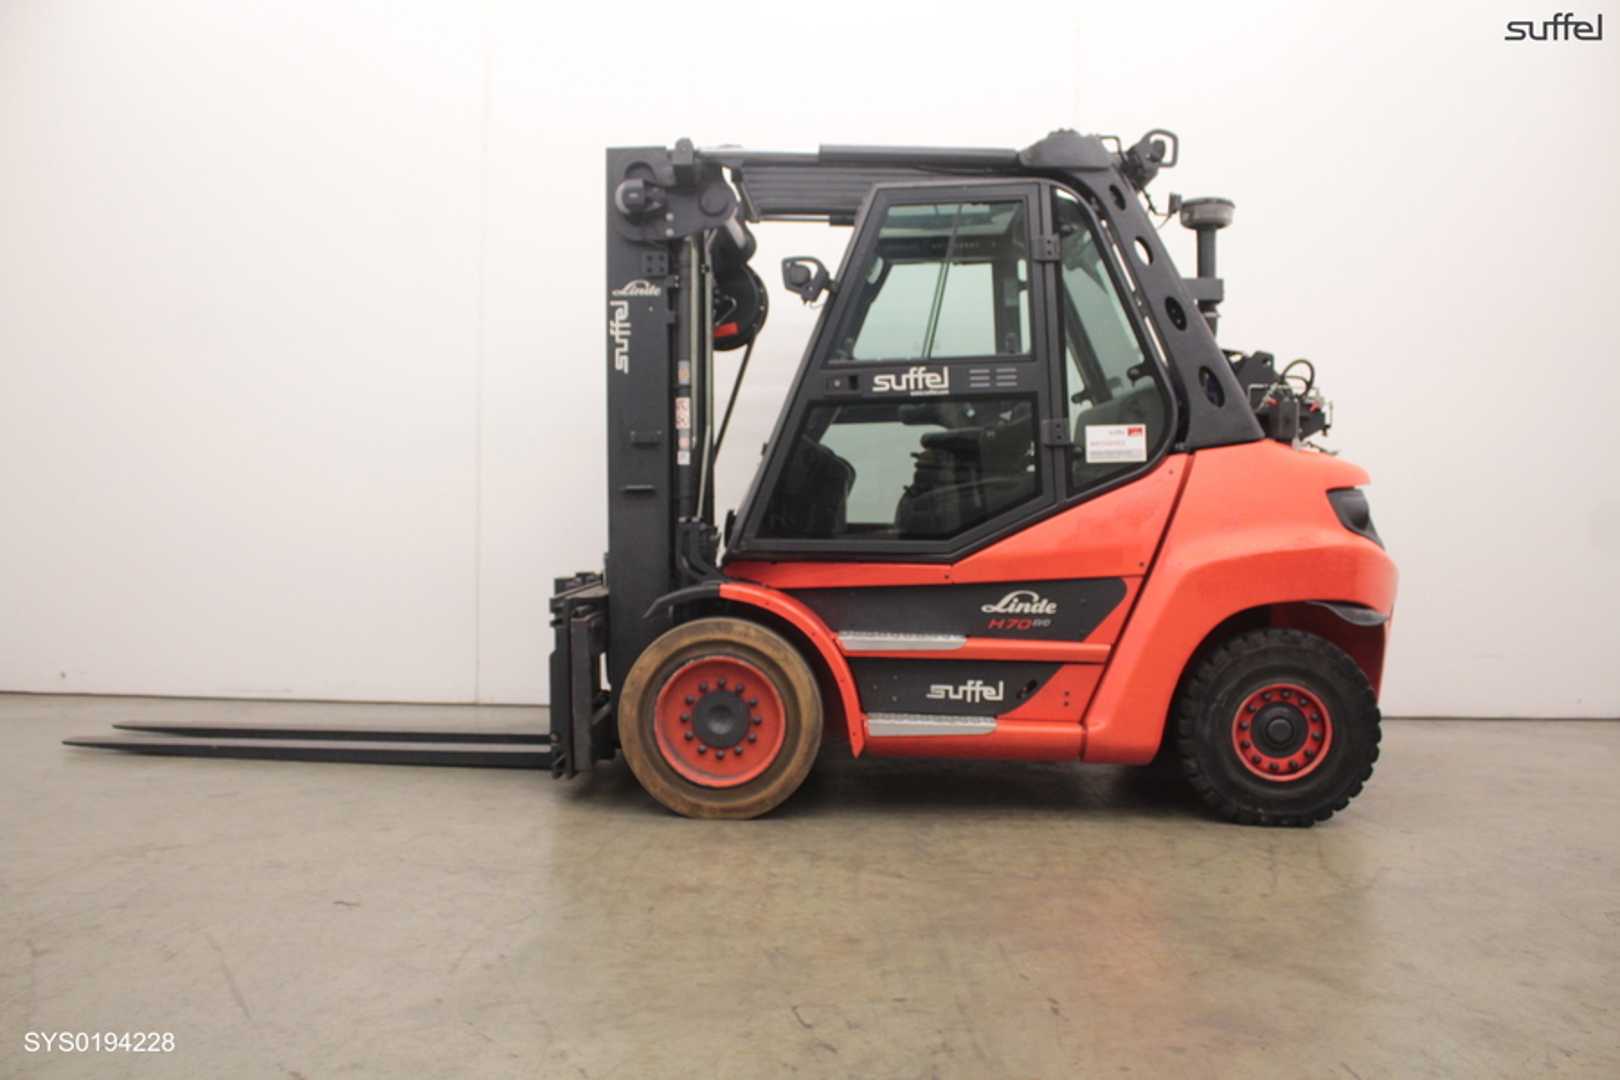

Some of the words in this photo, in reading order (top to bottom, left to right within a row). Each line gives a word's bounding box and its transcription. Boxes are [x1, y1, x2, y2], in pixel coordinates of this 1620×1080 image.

[611, 279, 661, 297] Linde
[609, 300, 631, 374] suffel
[872, 365, 949, 392] suffel
[981, 590, 1057, 614] Linde
[926, 680, 1004, 703] suffel
